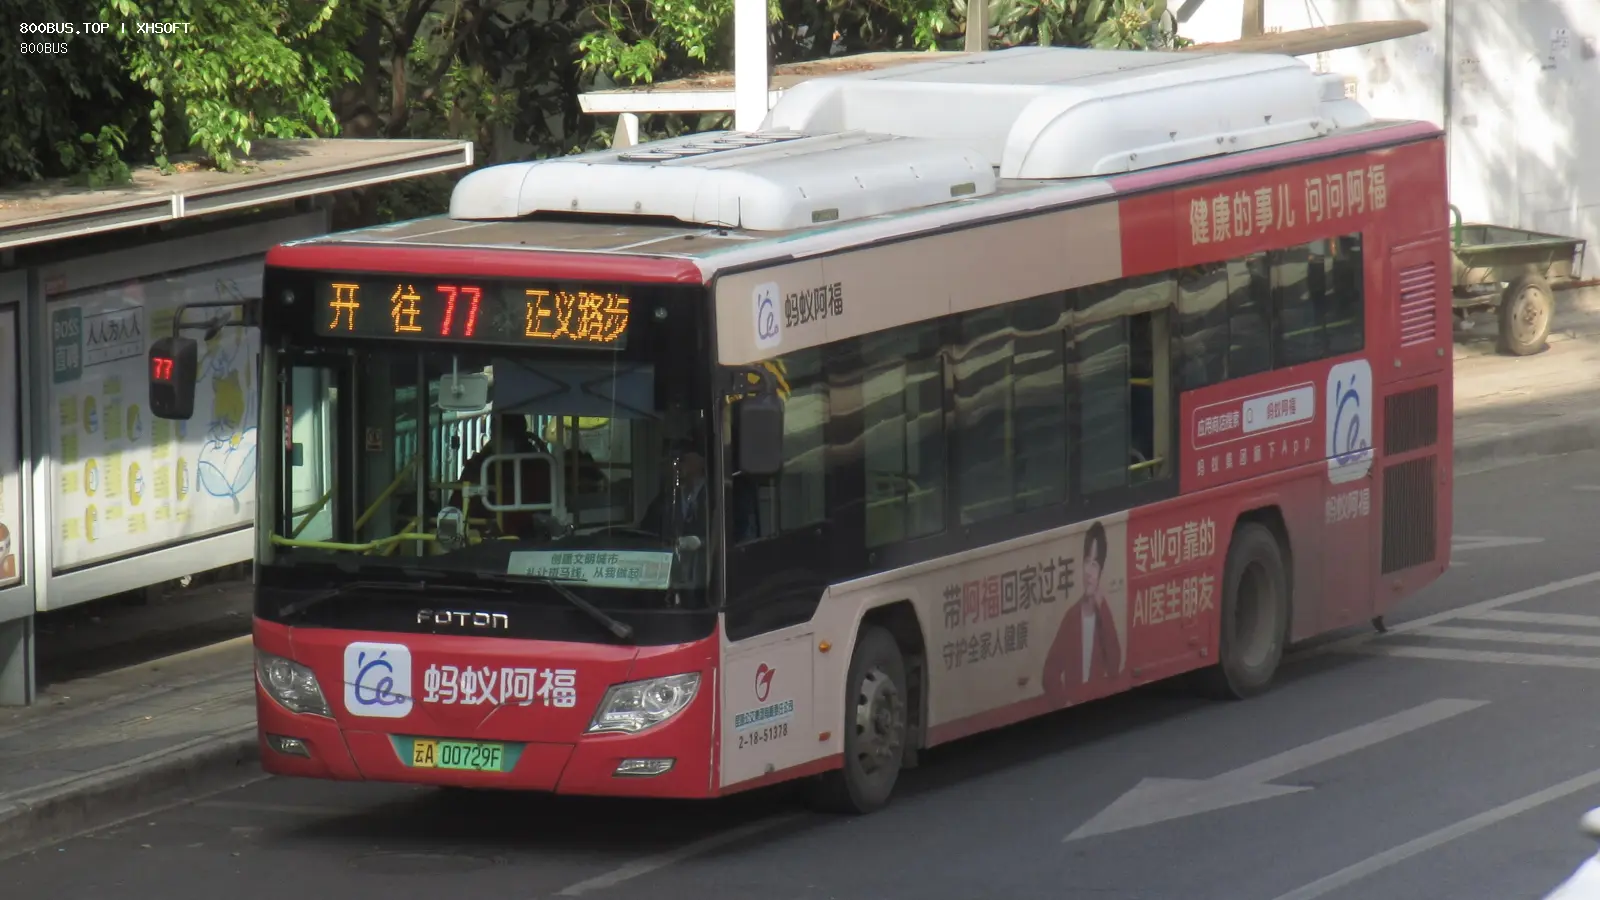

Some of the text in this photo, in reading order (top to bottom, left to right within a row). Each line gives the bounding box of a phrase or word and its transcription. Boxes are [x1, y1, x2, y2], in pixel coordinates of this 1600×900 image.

[1190, 164, 1387, 246] 健康的事儿 问问阿福
[437, 285, 480, 336] 77
[784, 282, 843, 328] 蚂蚁阿福
[153, 357, 173, 380] 77
[1133, 516, 1216, 573] 专业可靠的
[417, 608, 509, 629] FOTON
[943, 556, 1075, 630] 带阿福回家过年
[1132, 573, 1215, 628] AI医生朋友
[942, 620, 1029, 671] 守护全家人健康
[423, 664, 578, 708] 蚂蚁阿福
[738, 722, 788, 749] 2-18-51378
